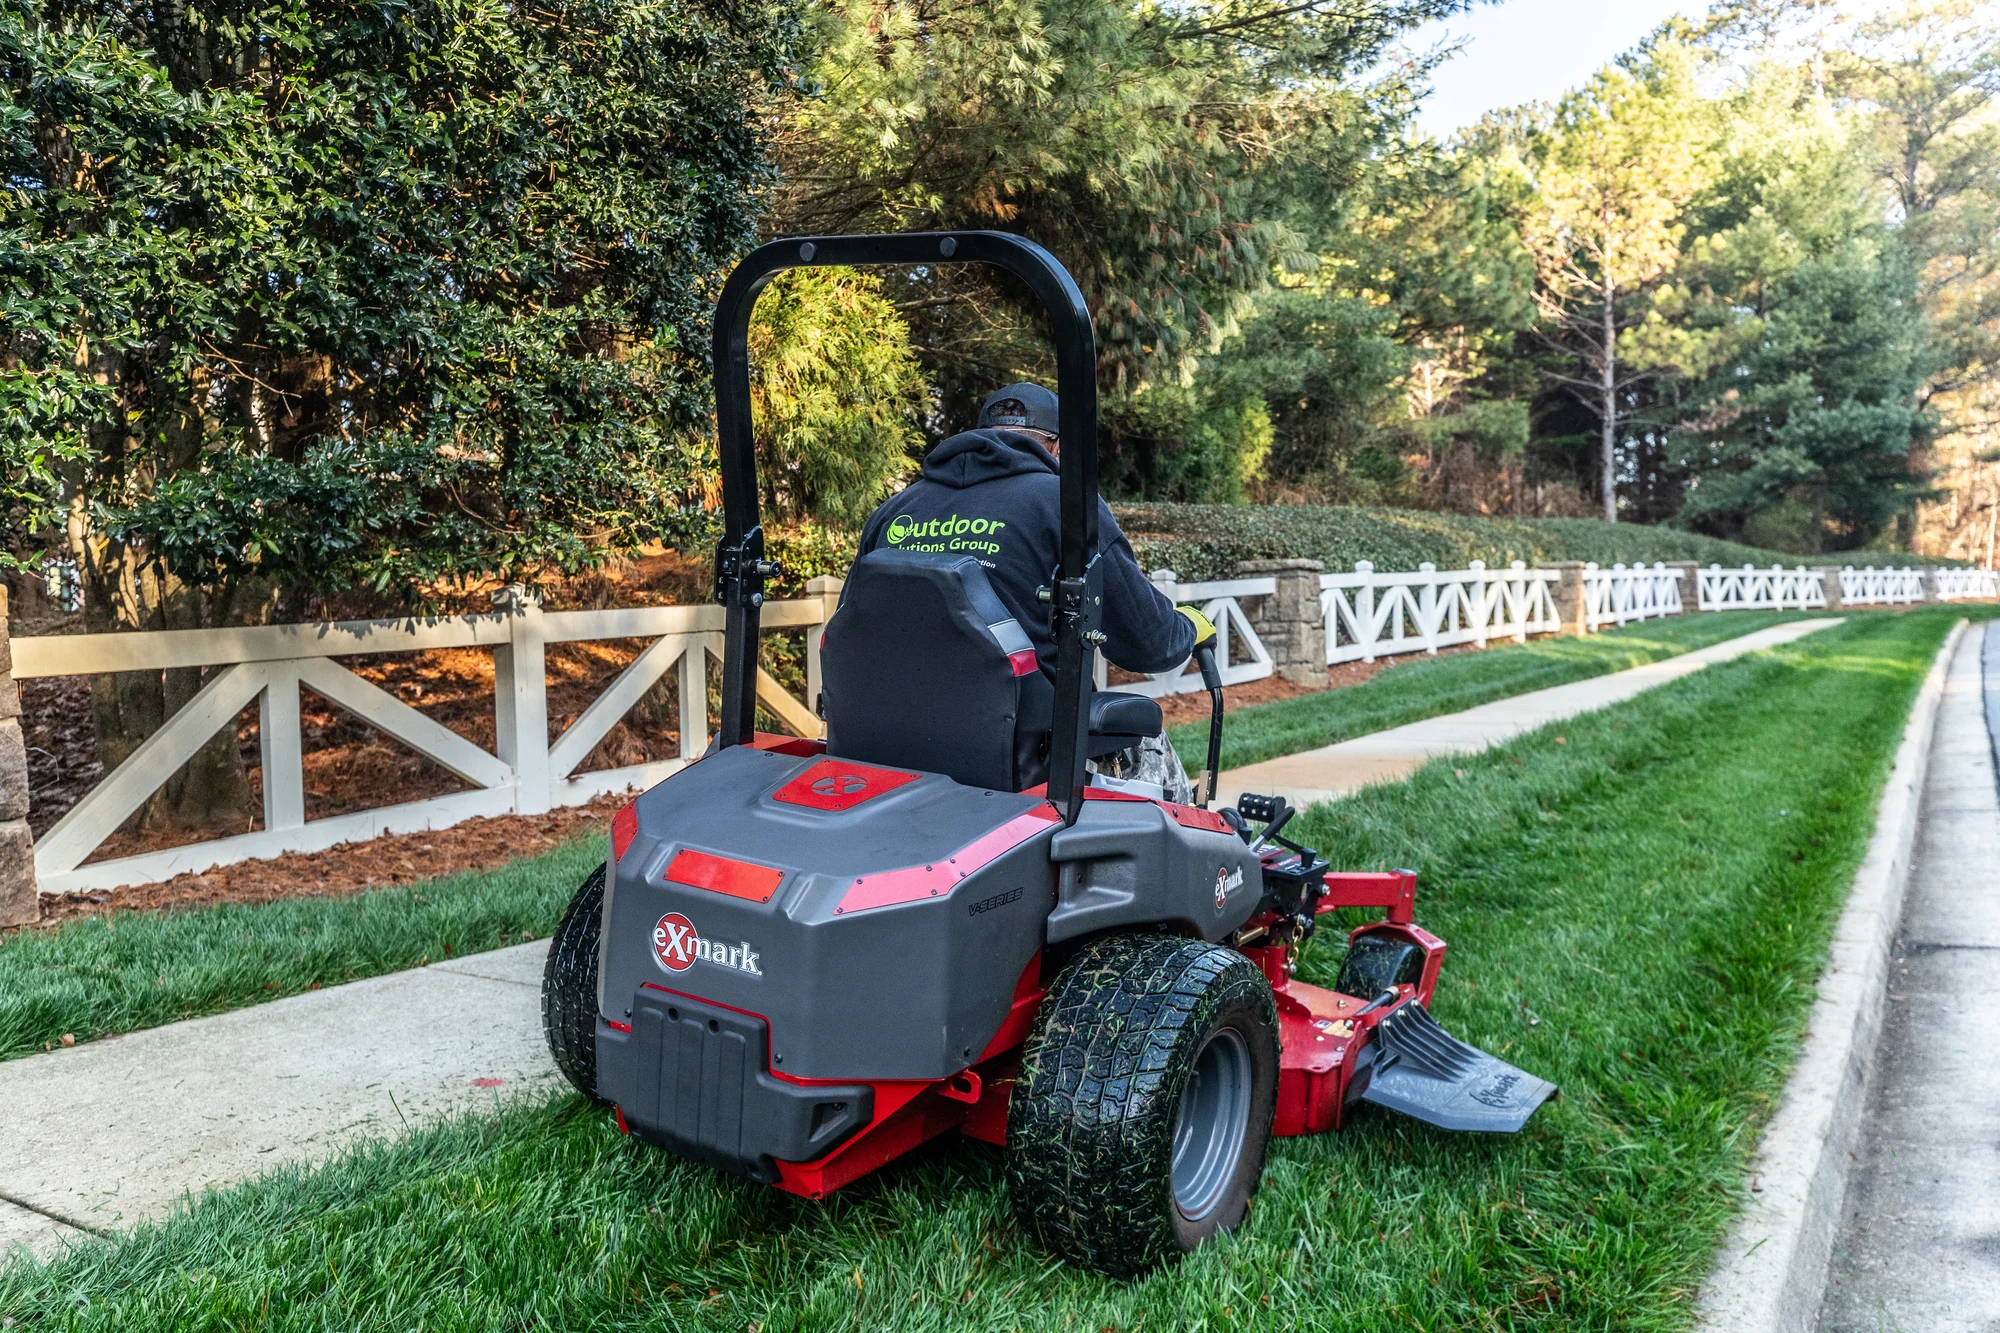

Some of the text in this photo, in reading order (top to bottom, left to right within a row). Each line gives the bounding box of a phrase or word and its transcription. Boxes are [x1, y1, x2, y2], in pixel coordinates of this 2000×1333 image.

[887, 514, 1006, 544] Outdoor
[949, 537, 1000, 555] Group
[968, 886, 1024, 917] V-SERIES
